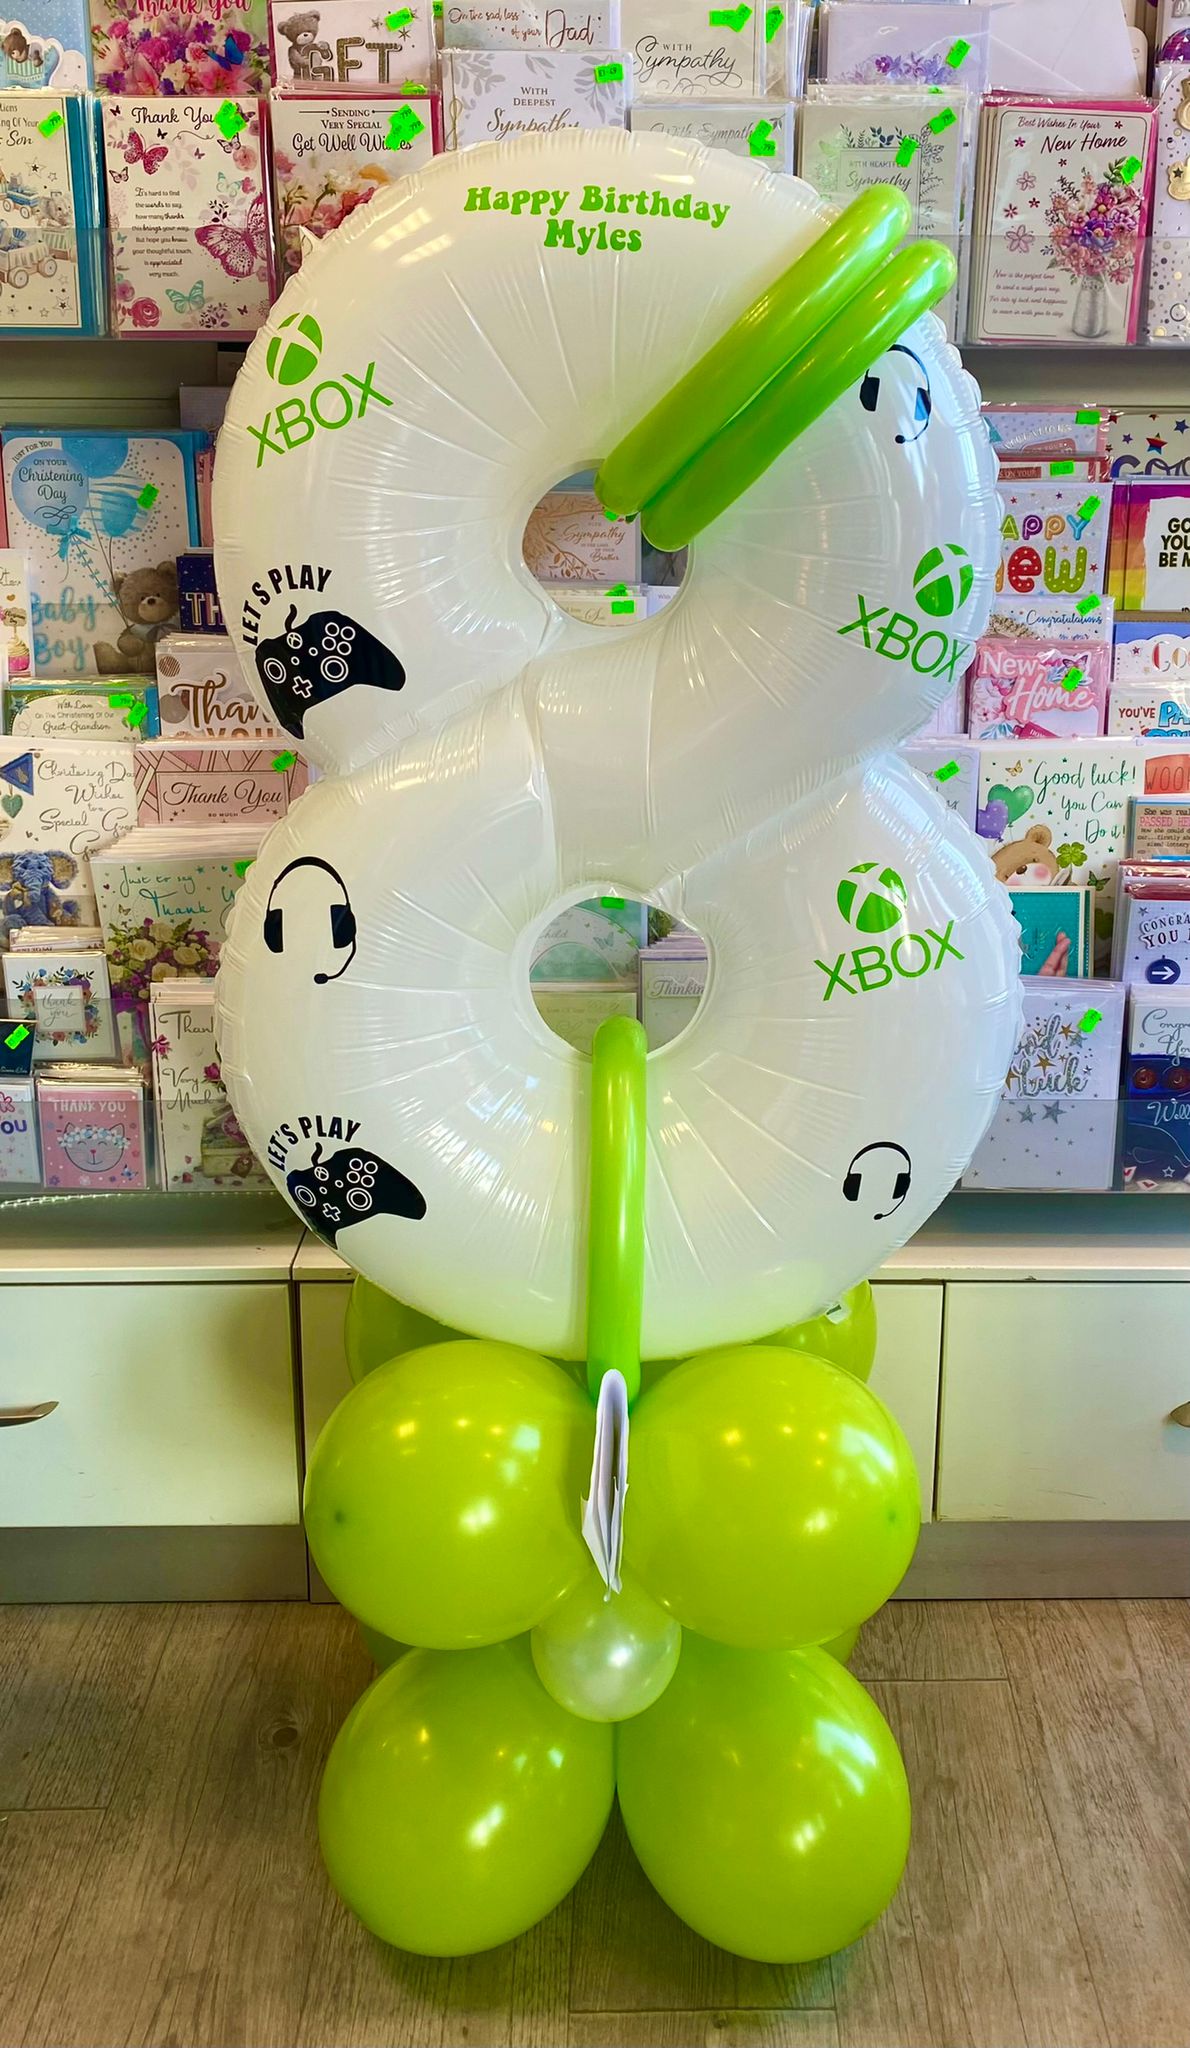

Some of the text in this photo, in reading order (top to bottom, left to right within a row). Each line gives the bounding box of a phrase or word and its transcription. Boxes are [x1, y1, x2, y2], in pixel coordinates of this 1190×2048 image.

[448, 7, 469, 24] On
[469, 8, 483, 20] the
[485, 8, 502, 21] sad
[504, 8, 520, 21] loss
[522, 28, 542, 41] your
[545, 8, 594, 49] Dad
[662, 43, 693, 52] WITH
[634, 36, 743, 88] Sympathy
[513, 97, 557, 107] DEEPEST
[520, 86, 549, 96] WITH
[131, 106, 180, 124] Thank
[331, 107, 371, 118] SENDING
[1018, 116, 1101, 132] Best Wishes In Your
[320, 119, 383, 130] VERY SPECIAL
[6, 129, 32, 146] Son
[292, 133, 357, 158] Get Well
[1040, 132, 1128, 155] New Home
[463, 185, 731, 229] Happy Birthday
[543, 218, 643, 256] Myles
[246, 361, 394, 468] XBOX
[12, 440, 54, 464] JUST FOR YOU
[33, 458, 68, 466] ON YOUR
[18, 466, 84, 487] Christening
[37, 484, 67, 505] Day
[562, 523, 626, 545] Sympathy
[1000, 514, 1091, 541] APPY
[1159, 552, 1178, 567] BE
[267, 564, 332, 595] PLAY
[30, 586, 99, 632] Baby
[1026, 609, 1103, 628] Congratulations
[836, 593, 970, 683] XBOX
[31, 632, 91, 672] Boy
[982, 651, 1039, 676] New
[170, 672, 272, 729] Than
[1007, 673, 1095, 721] Home
[1118, 706, 1156, 719] YOU'VE
[43, 720, 112, 734] Great-Grandson
[64, 783, 124, 805] Wishes
[1033, 760, 1137, 805] Good luck!
[163, 778, 284, 814] Thank You
[1091, 791, 1124, 811] Can
[39, 808, 89, 832] Special
[1139, 816, 1174, 827] PASSED
[1144, 808, 1157, 816] She
[1085, 819, 1126, 844] Do it!
[119, 865, 196, 898] Just to say
[139, 887, 213, 918] Thank
[1142, 929, 1179, 948] YOU
[813, 919, 965, 1002] XBOX
[651, 979, 707, 997] Thinkin
[43, 992, 79, 1009] thank
[162, 1067, 199, 1094] Very
[1013, 1056, 1089, 1098] Luck
[52, 1099, 127, 1113] THANK YOU
[166, 1088, 215, 1113] Much
[267, 1115, 362, 1172] LET'S PLAY
